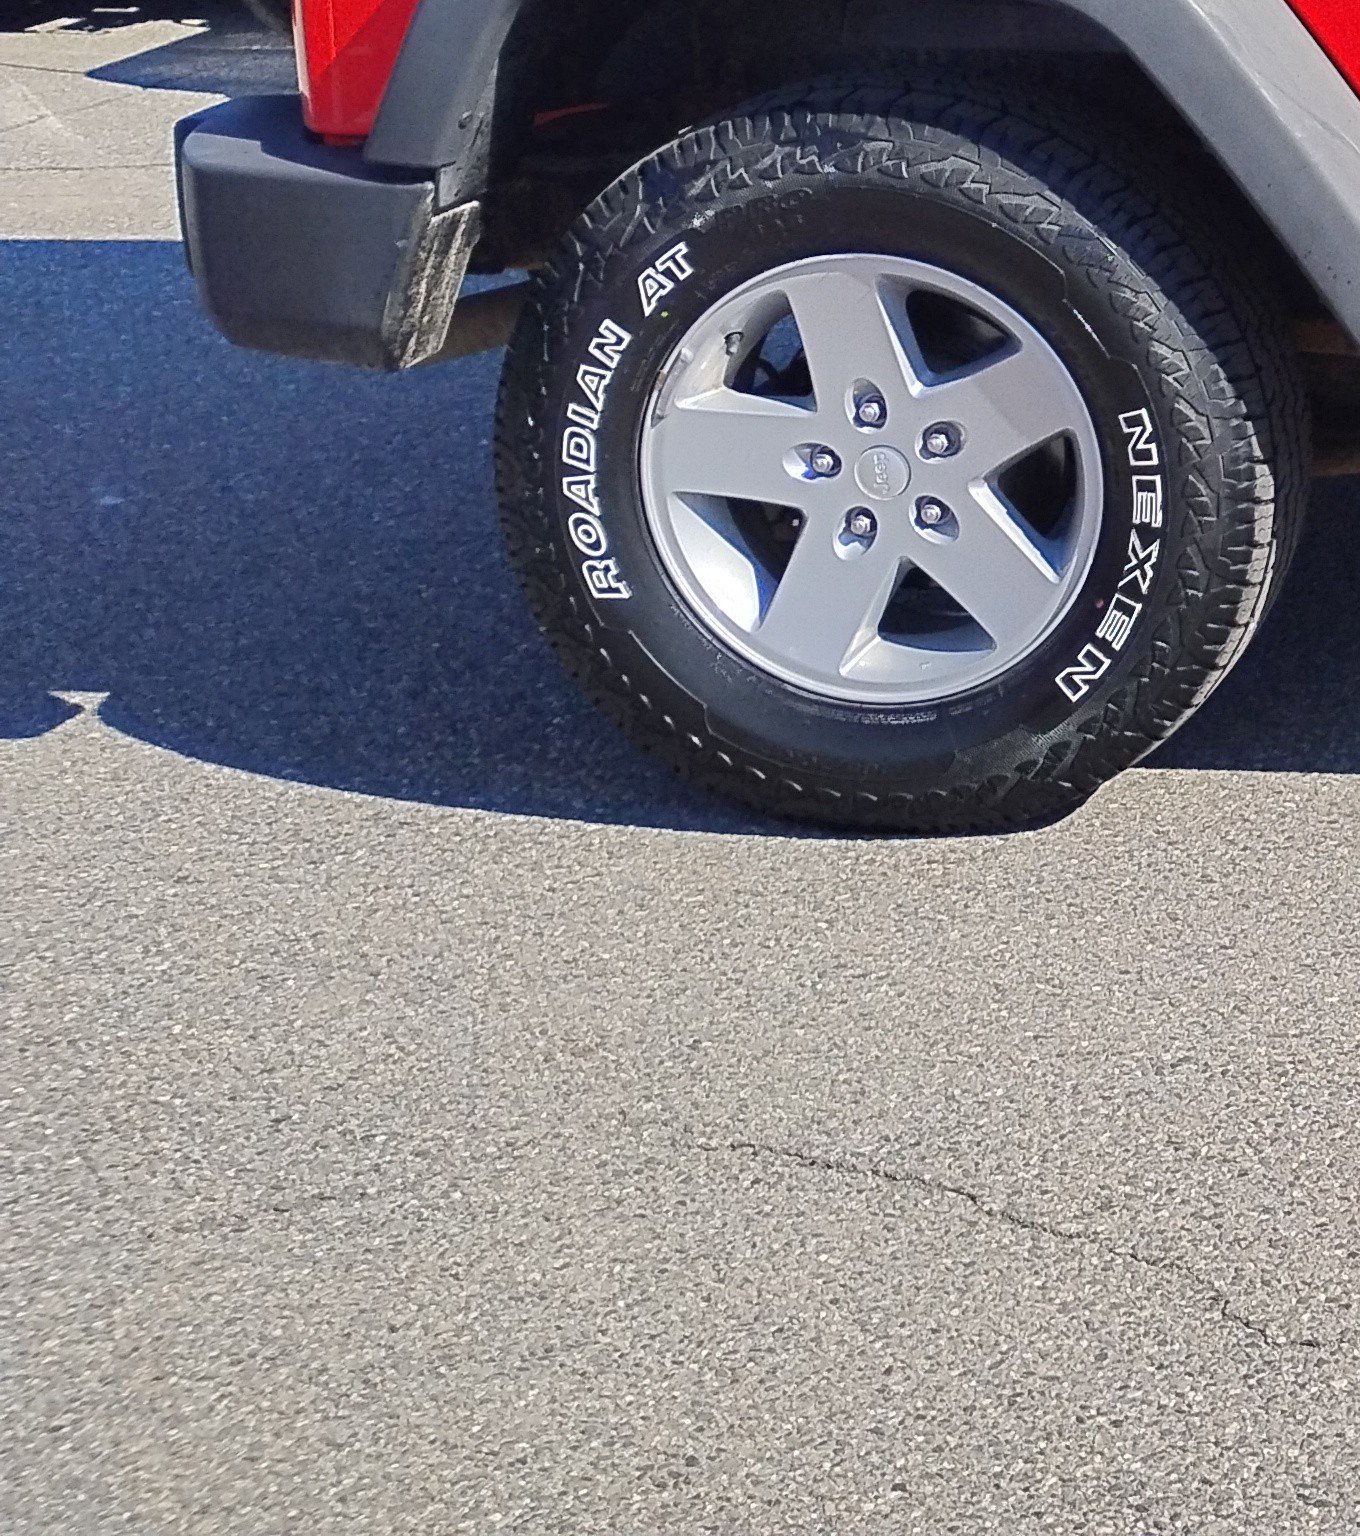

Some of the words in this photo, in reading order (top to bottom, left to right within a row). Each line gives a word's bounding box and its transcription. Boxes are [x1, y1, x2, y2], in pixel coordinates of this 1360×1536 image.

[562, 318, 633, 600] ROADIAN
[637, 241, 694, 318] AT
[1055, 407, 1162, 703] NEXEN
